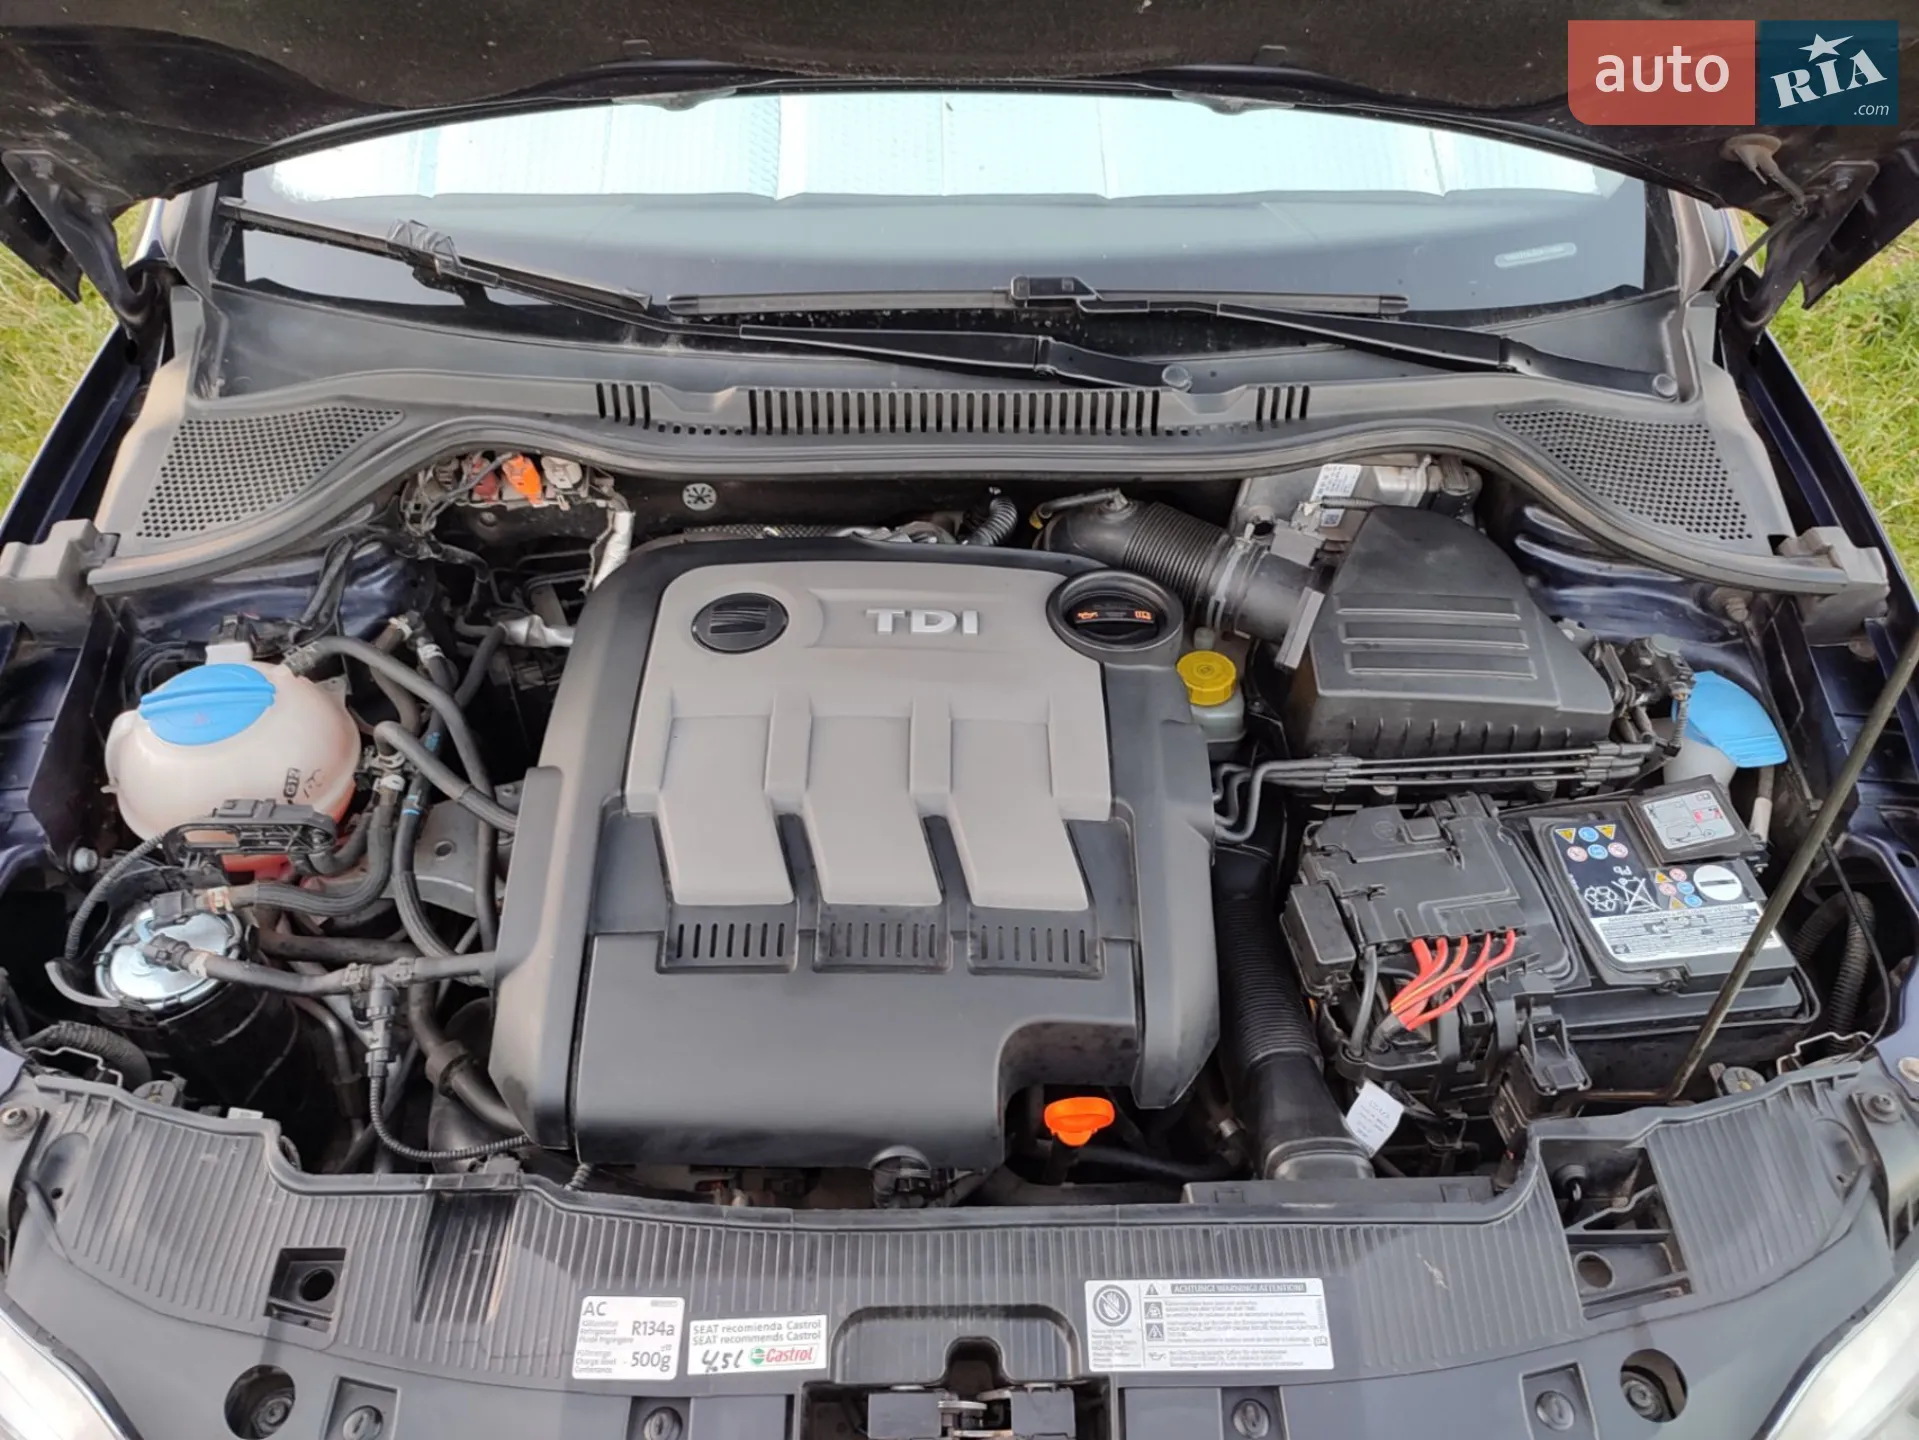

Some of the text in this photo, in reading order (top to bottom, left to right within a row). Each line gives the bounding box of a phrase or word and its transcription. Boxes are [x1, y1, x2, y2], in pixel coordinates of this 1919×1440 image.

[866, 608, 978, 634] TDI
[582, 1301, 607, 1316] AC
[632, 1320, 675, 1336] R134a
[693, 1319, 821, 1334] SEAT recomienda Castrol
[692, 1330, 821, 1346] SEAT recommends Castrol
[631, 1351, 672, 1372] 500g
[766, 1347, 813, 1363] Castrol
